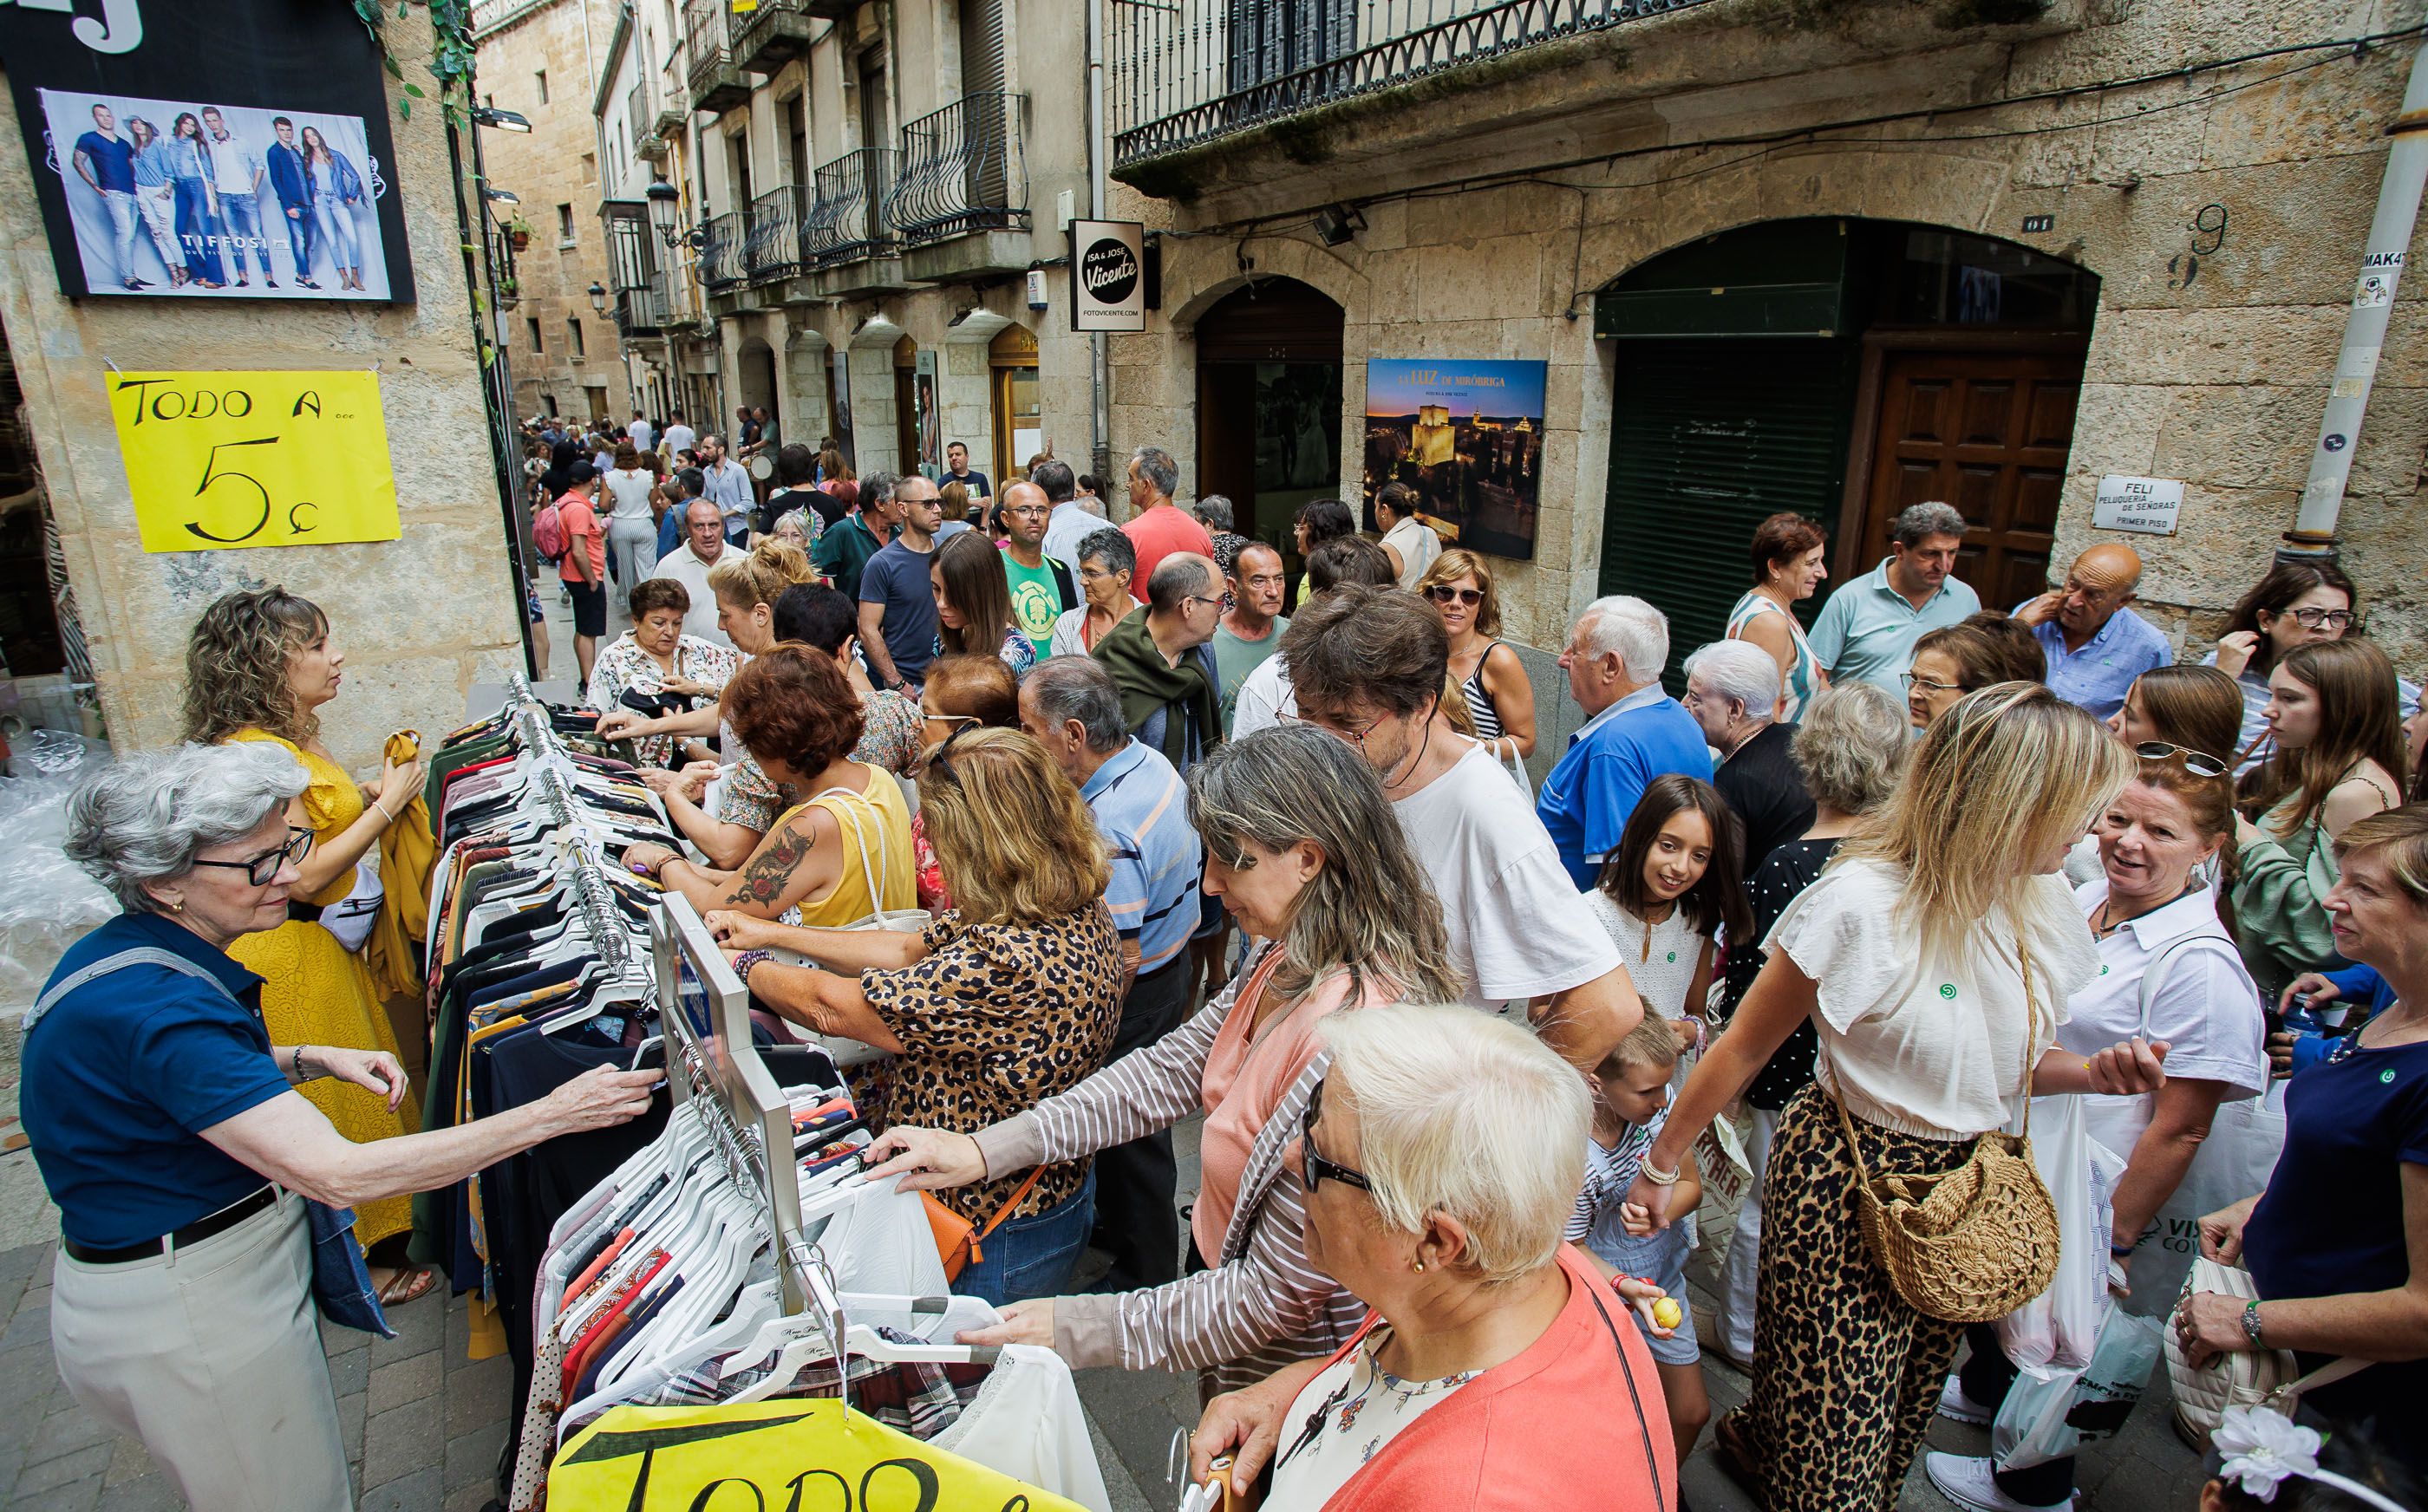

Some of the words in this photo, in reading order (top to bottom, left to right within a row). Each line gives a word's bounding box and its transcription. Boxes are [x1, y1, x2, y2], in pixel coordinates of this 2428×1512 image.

[2191, 205, 2227, 255] 9
[181, 234, 267, 249] TIFFOSI
[1087, 252, 1100, 262] ISA
[1107, 246, 1126, 258] JOSE
[1087, 253, 1138, 290] Vicente
[1411, 369, 1439, 386] LUZ
[116, 379, 252, 427] TODO
[185, 435, 280, 543] 5
[2124, 483, 2153, 494] FELI
[2098, 495, 2147, 504] PELUQUERIA
[2136, 500, 2177, 511] SEÑORAS
[2116, 516, 2145, 525] PRIMER
[2148, 519, 2167, 528] PISO
